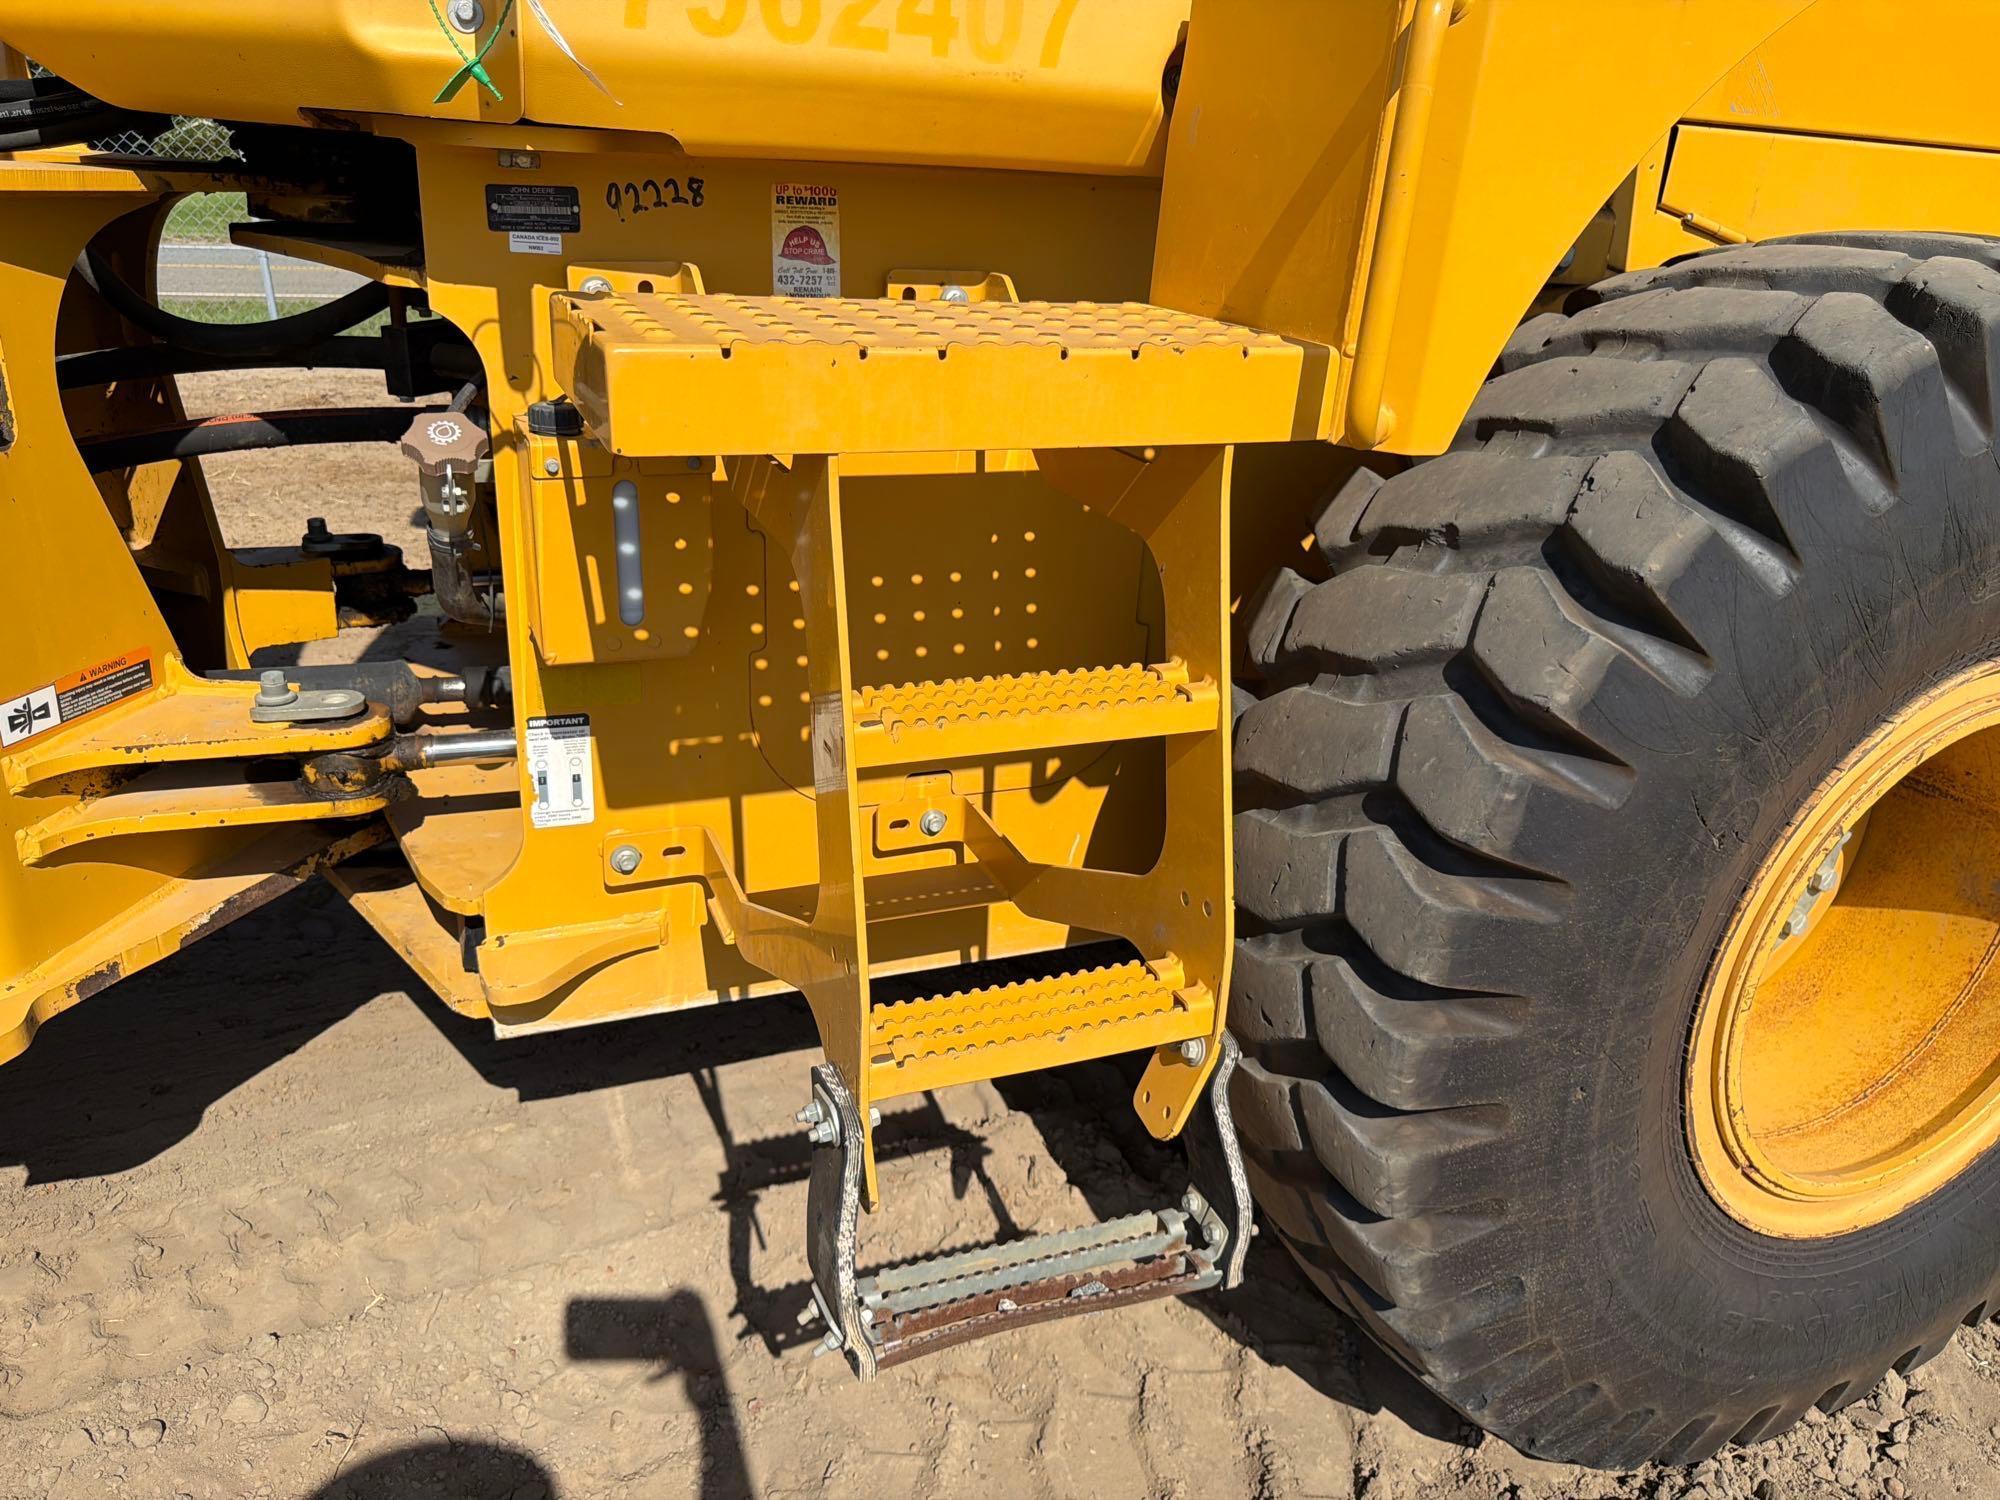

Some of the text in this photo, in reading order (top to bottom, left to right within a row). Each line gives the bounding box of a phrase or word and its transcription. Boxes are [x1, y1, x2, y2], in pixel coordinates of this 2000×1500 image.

[532, 187, 555, 195] DEERE
[775, 185, 789, 195] UP
[776, 195, 837, 206] REWARD
[512, 233, 535, 241] CANADA
[789, 236, 820, 249] HELP US
[803, 248, 825, 256] CRIME
[89, 657, 127, 678] WARNING
[528, 717, 585, 728] IMPORTANT
